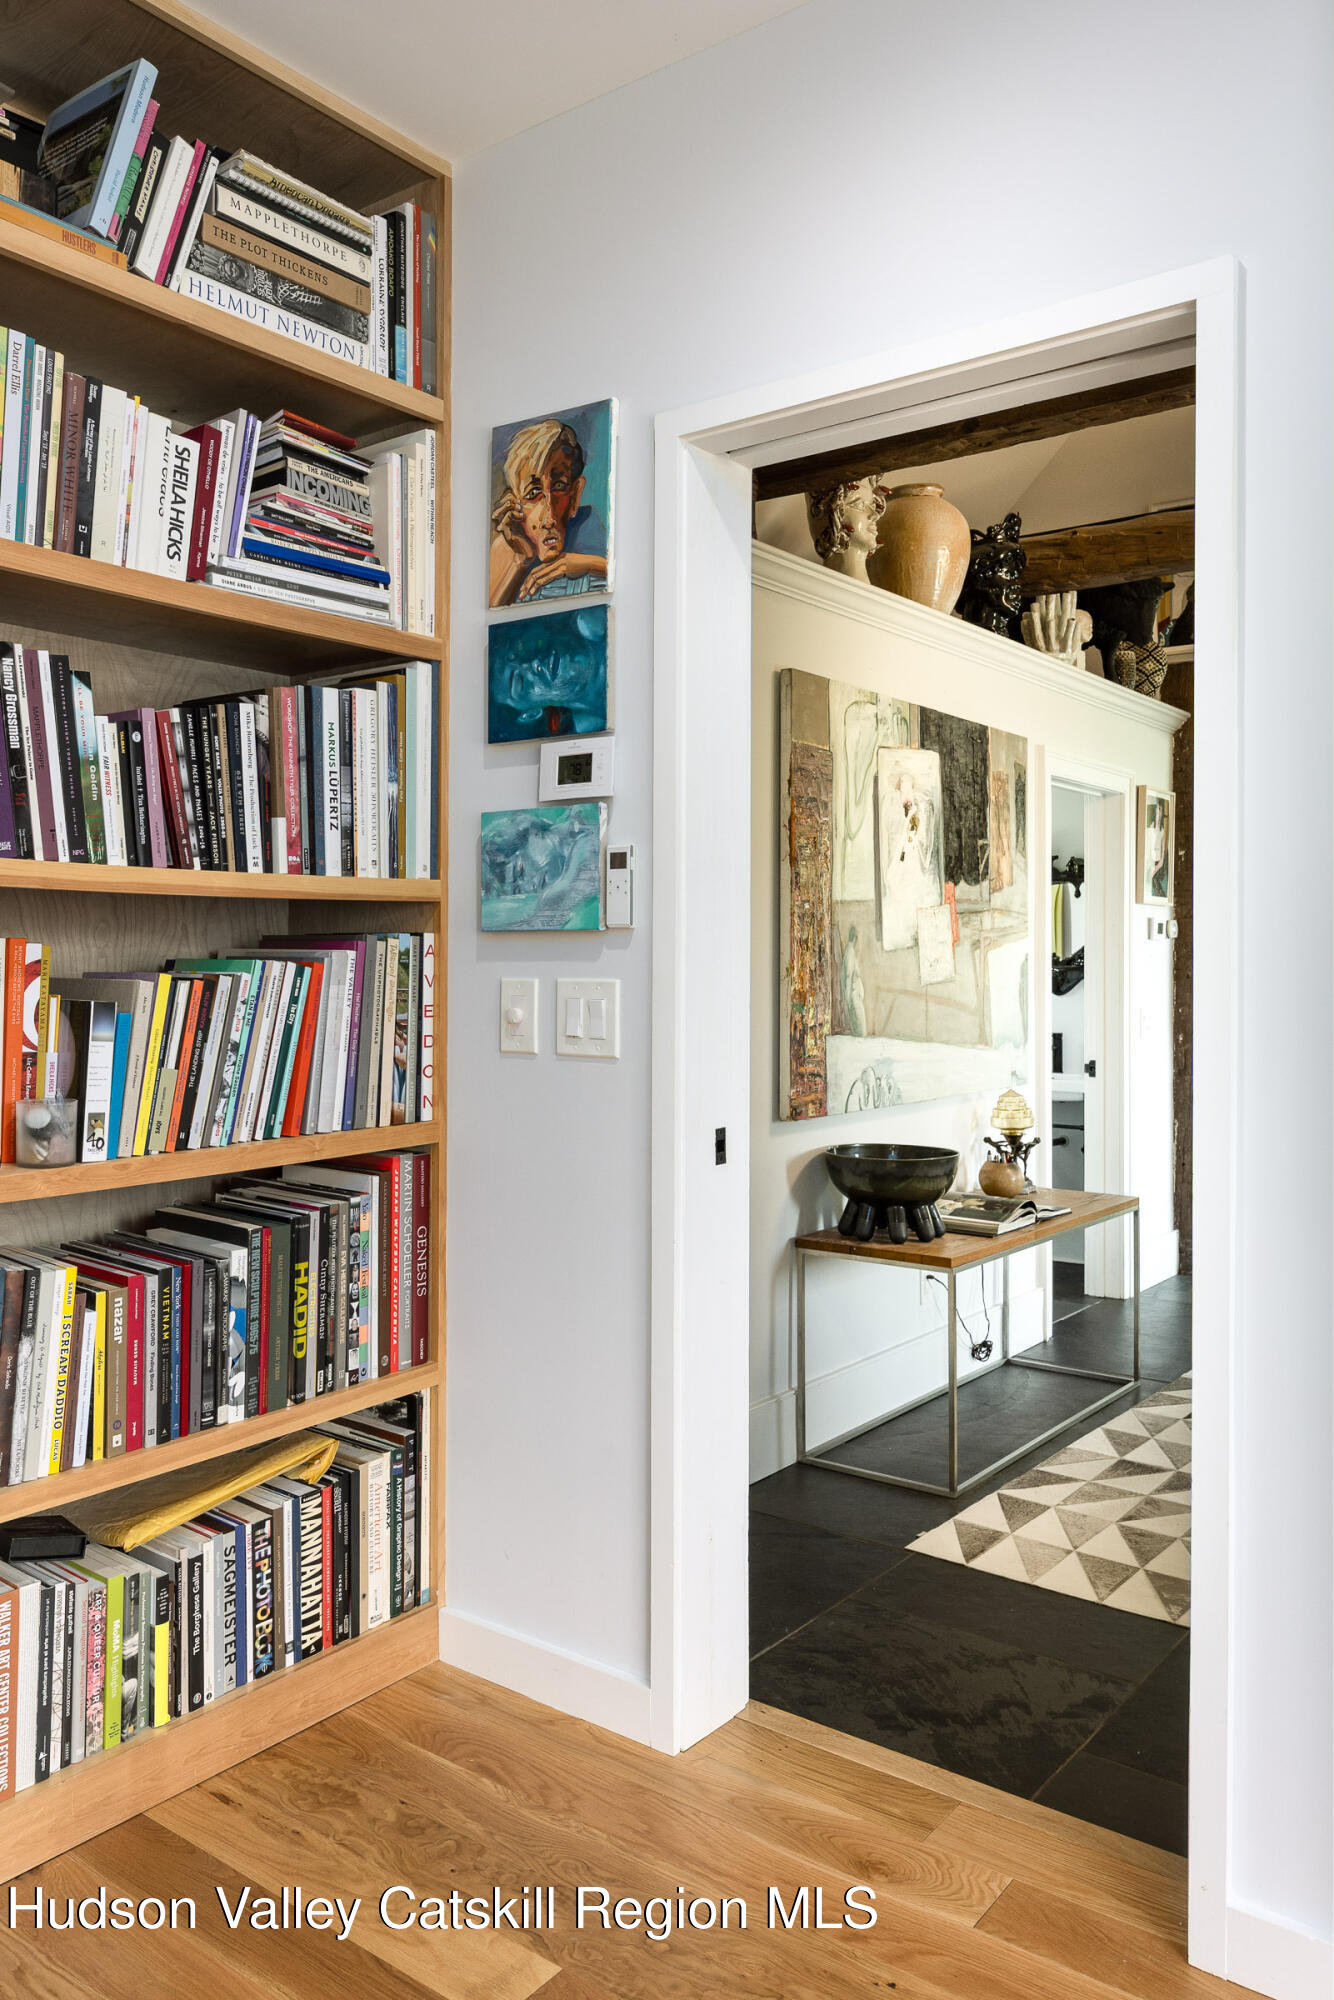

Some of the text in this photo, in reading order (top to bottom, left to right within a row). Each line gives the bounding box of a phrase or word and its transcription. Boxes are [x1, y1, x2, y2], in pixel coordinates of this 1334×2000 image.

[62, 229, 96, 256] HUSTLERS
[230, 197, 348, 262] MAPPLETHORPE
[212, 224, 236, 246] THE
[240, 239, 269, 263] PLOT
[271, 251, 328, 288] THICKENS
[378, 258, 387, 304] LORRAINE
[189, 276, 270, 324] HELMUT
[276, 314, 356, 361] NEWTON
[10, 341, 23, 396] Darrel Ellis
[222, 425, 233, 449] herman
[62, 409, 80, 513] MINOR WHITE
[172, 444, 191, 505] SHEILA
[220, 460, 228, 475] vries
[305, 464, 319, 479] THE
[319, 469, 354, 488] AMERICANS
[286, 468, 372, 518] INCOMING
[166, 506, 187, 563] HICKS
[213, 510, 221, 526] ways
[249, 551, 270, 561] CARRIE
[2, 657, 20, 749] Nancy Grossman
[369, 700, 377, 745] GREGORY
[32, 705, 46, 771] MAPPLETHORPE
[246, 731, 255, 769] Rottenberg
[89, 764, 98, 801] Goldin
[102, 755, 112, 797] FAIR WITNESS
[205, 765, 213, 790] YEARS
[248, 774, 256, 788] The
[328, 721, 341, 832] MARKUS LÜPERTZ
[209, 810, 217, 830] JACK
[249, 789, 258, 824] Production
[289, 797, 298, 838] COLLECTION
[210, 832, 220, 865] PIERSON
[195, 1029, 203, 1047] STRIP
[423, 943, 435, 1110] AVEDON
[188, 1075, 196, 1088] THE
[190, 1048, 200, 1075] LANDING
[403, 1159, 413, 1212] MARTIN
[403, 1216, 413, 1287] SCHOELLER
[416, 1225, 428, 1297] GENESIS
[27, 1275, 38, 1290] OUT
[65, 1280, 73, 1305] SARAH
[149, 1288, 157, 1307] GREY
[248, 1231, 260, 1354] THE NEW SCULPTURE 1965-75
[25, 1315, 35, 1329] BLUE
[26, 1302, 36, 1315] THE
[112, 1295, 125, 1344] nazar
[149, 1308, 157, 1346] CRAWFORD
[161, 1286, 171, 1340] VIETNAM
[292, 1260, 309, 1359] HADID
[57, 1322, 71, 1375] SCREAM
[53, 1378, 67, 1430] DADDIO
[51, 1438, 60, 1461] LUCAS
[393, 1483, 402, 1509] History
[256, 1518, 273, 1559] THE
[372, 1481, 385, 1572] American Art
[393, 1522, 402, 1550] Graphic
[300, 1497, 323, 1651] MANNAHATTA
[393, 1552, 402, 1582] Design
[93, 1592, 103, 1610] ART
[191, 1562, 202, 1657] The Borghese Gallery
[223, 1543, 237, 1669] SAGMEISTER
[0, 1599, 12, 1648] WALKER
[91, 1622, 102, 1658] QUEER
[0, 1650, 11, 1670] ART
[110, 1617, 121, 1699] MoMA Highlights
